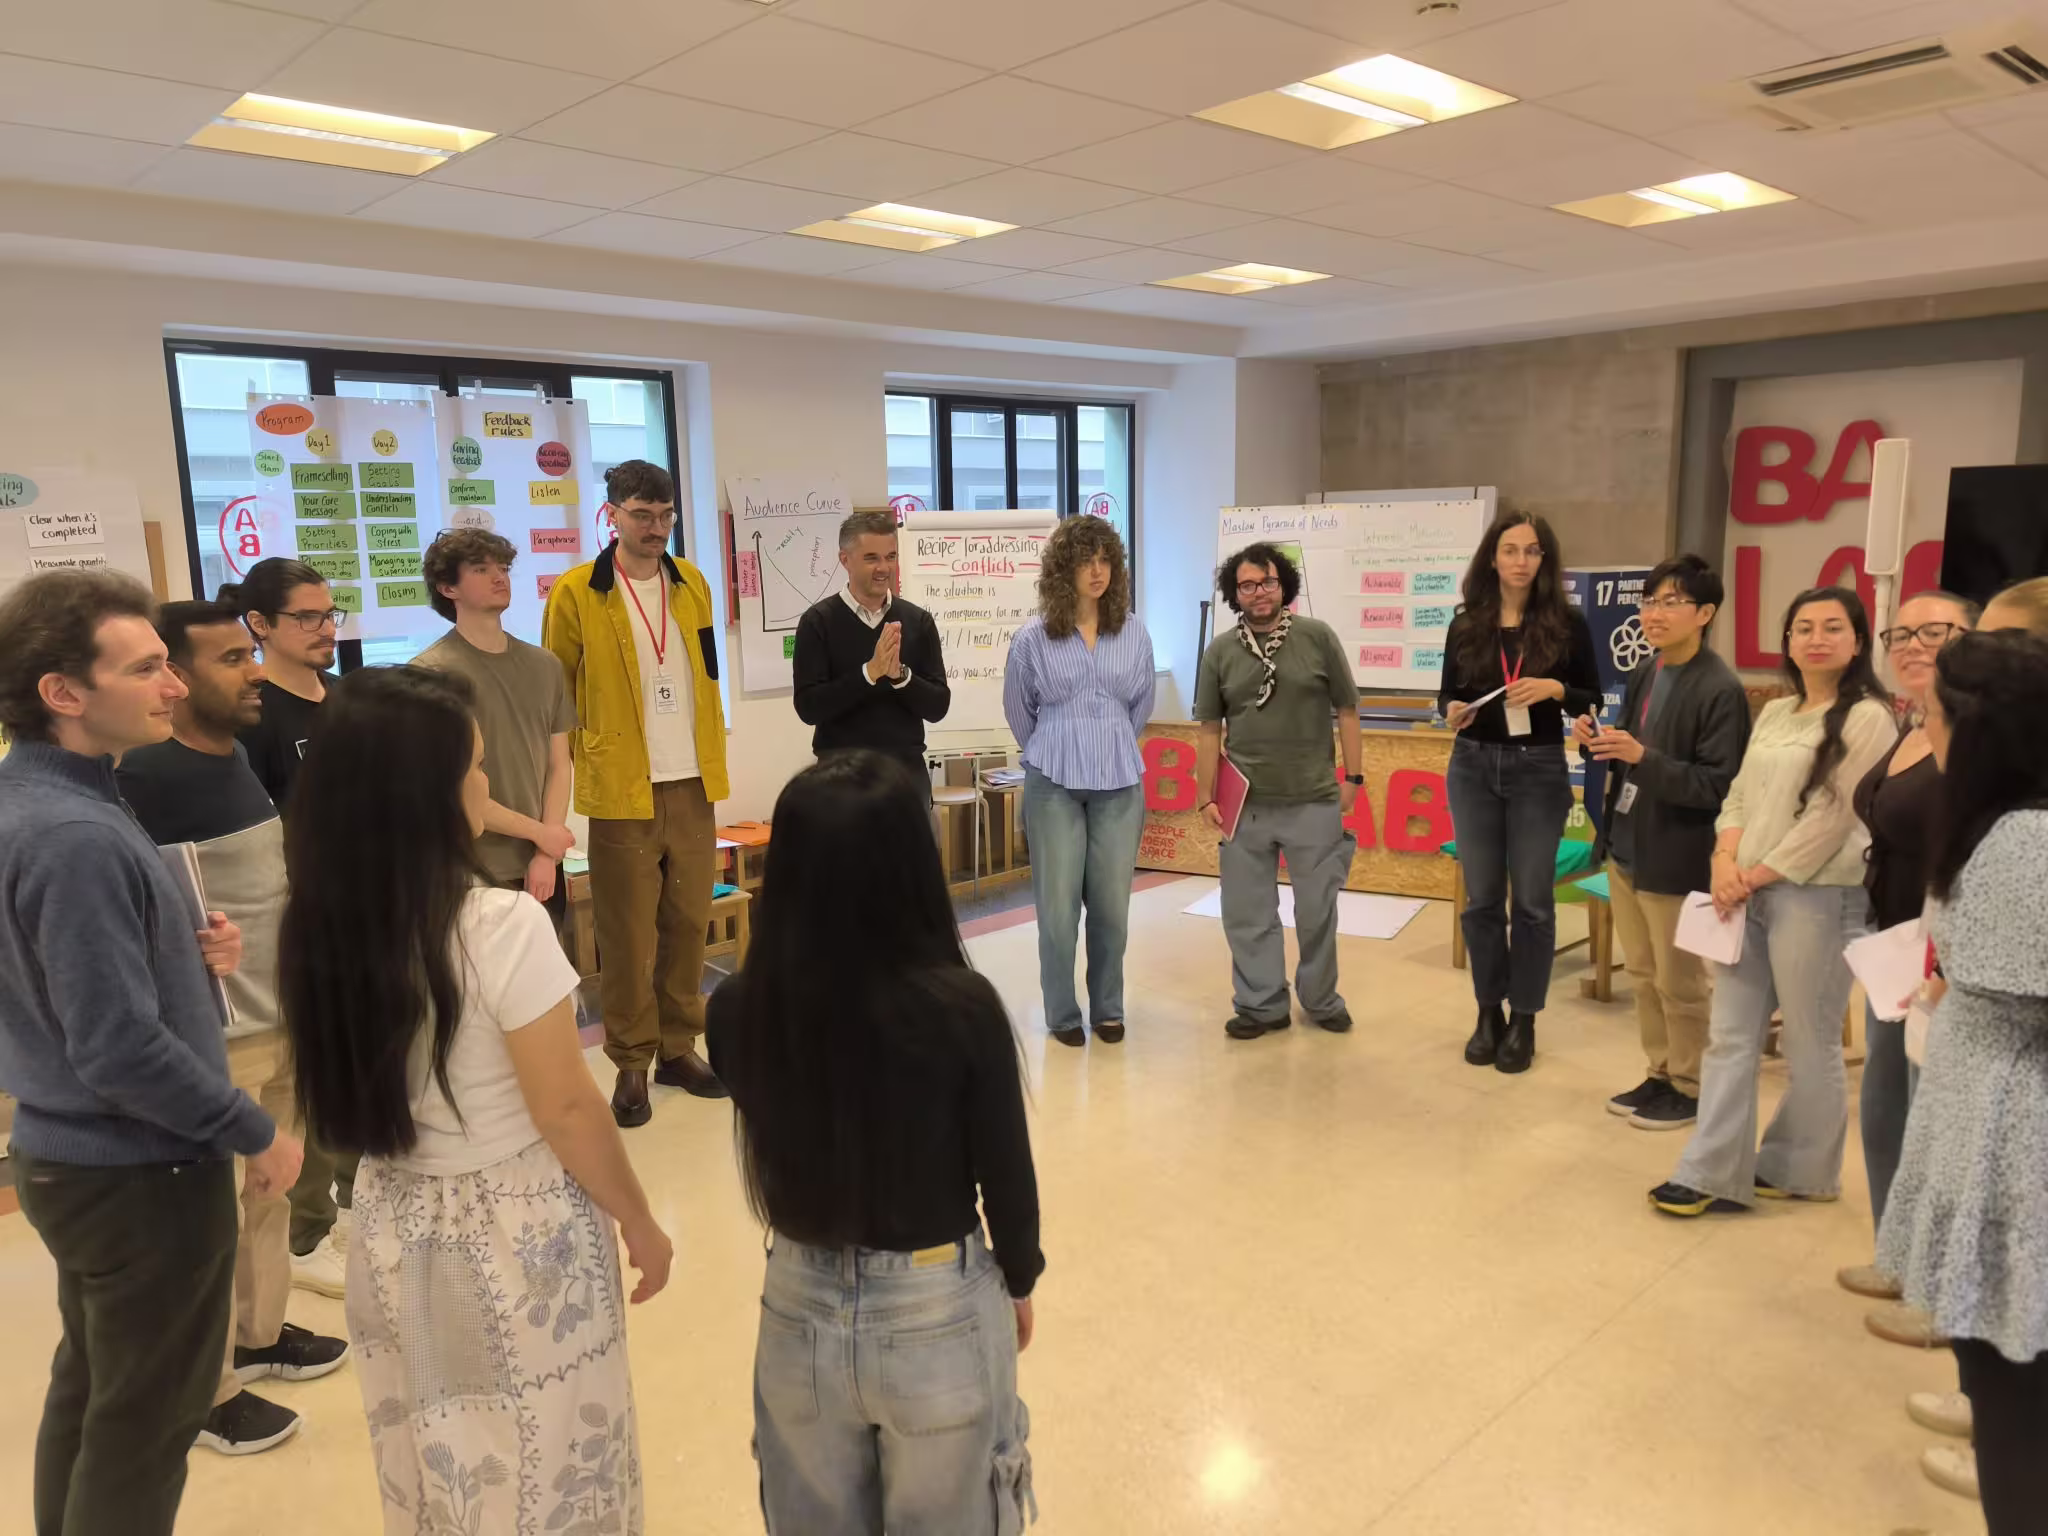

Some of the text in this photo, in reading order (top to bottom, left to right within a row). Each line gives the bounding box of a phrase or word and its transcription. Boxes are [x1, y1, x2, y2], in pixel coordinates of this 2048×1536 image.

[261, 410, 305, 428] Program
[485, 412, 531, 426] Feedback
[491, 427, 524, 437] rules
[307, 435, 325, 451] Day
[368, 463, 400, 478] Setting
[531, 485, 561, 498] Listen
[300, 496, 319, 506] Your
[745, 492, 841, 517] Audience Curve
[57, 513, 81, 523] when
[304, 506, 340, 518] message
[42, 524, 96, 542] completed
[305, 526, 336, 539] Setting
[371, 526, 396, 539] Coping
[301, 538, 348, 550] Priorities
[918, 537, 1039, 558] Recipe for addressing
[369, 555, 405, 569] Managing
[951, 556, 1015, 577] Conflicts
[381, 587, 417, 601] Closing
[926, 583, 941, 597] The
[988, 585, 996, 597] is
[1596, 581, 1614, 606] 17
[974, 632, 993, 646] need
[947, 666, 959, 679] do
[963, 667, 979, 680] you
